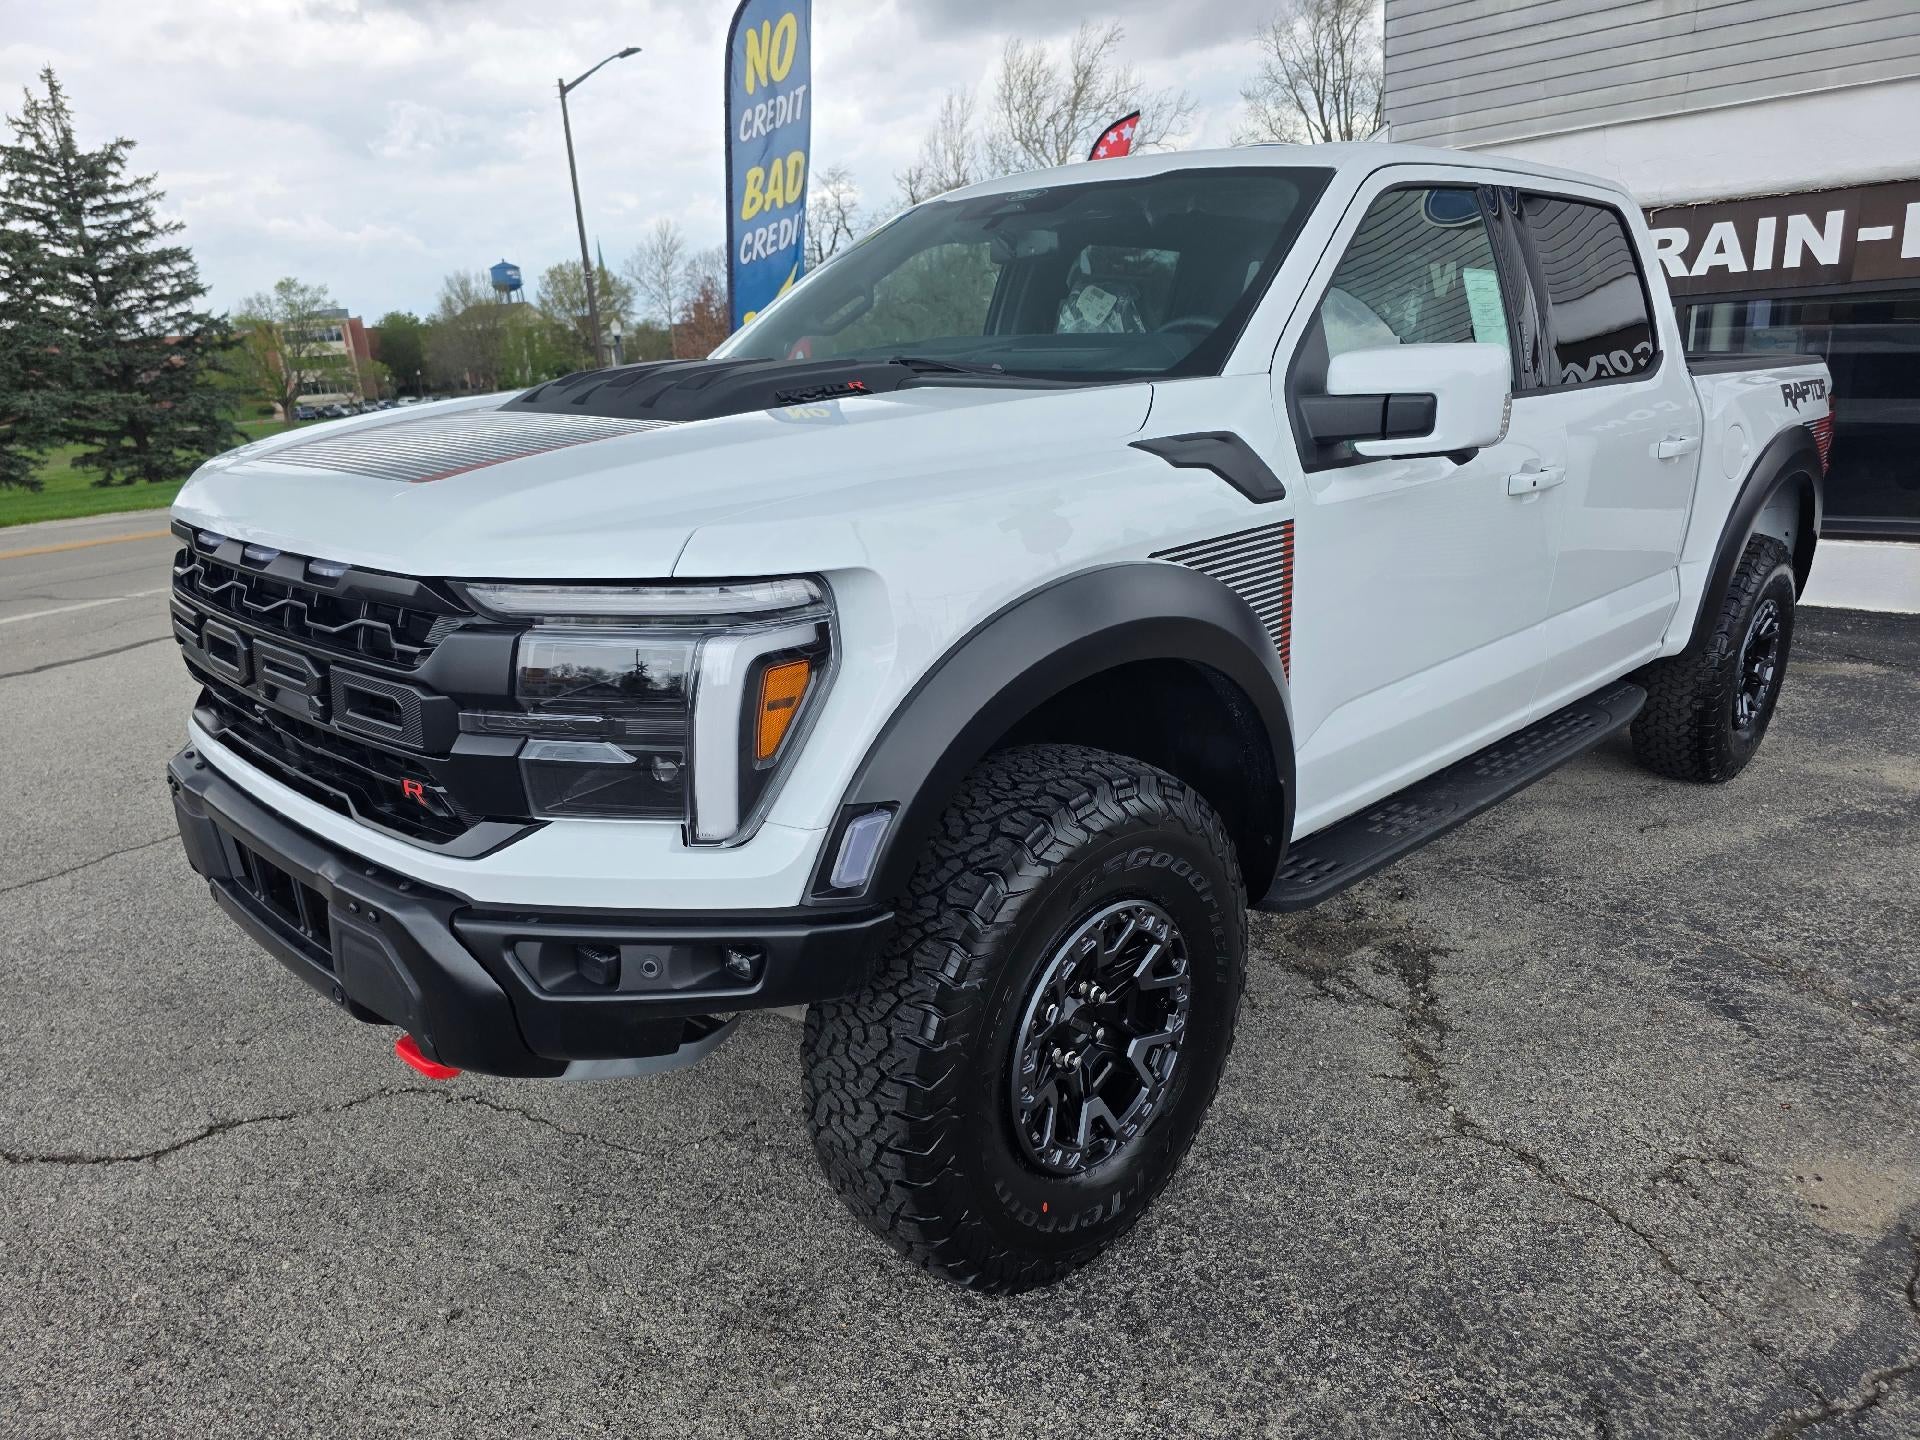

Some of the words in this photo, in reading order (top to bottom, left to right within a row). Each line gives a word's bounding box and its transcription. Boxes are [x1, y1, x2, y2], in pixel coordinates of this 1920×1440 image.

[745, 12, 798, 95] NO
[739, 84, 807, 142] CREDIT
[741, 151, 805, 220] BAD
[1780, 378, 1828, 414] RAPTOR
[169, 597, 424, 750] FORD
[403, 778, 432, 808] R
